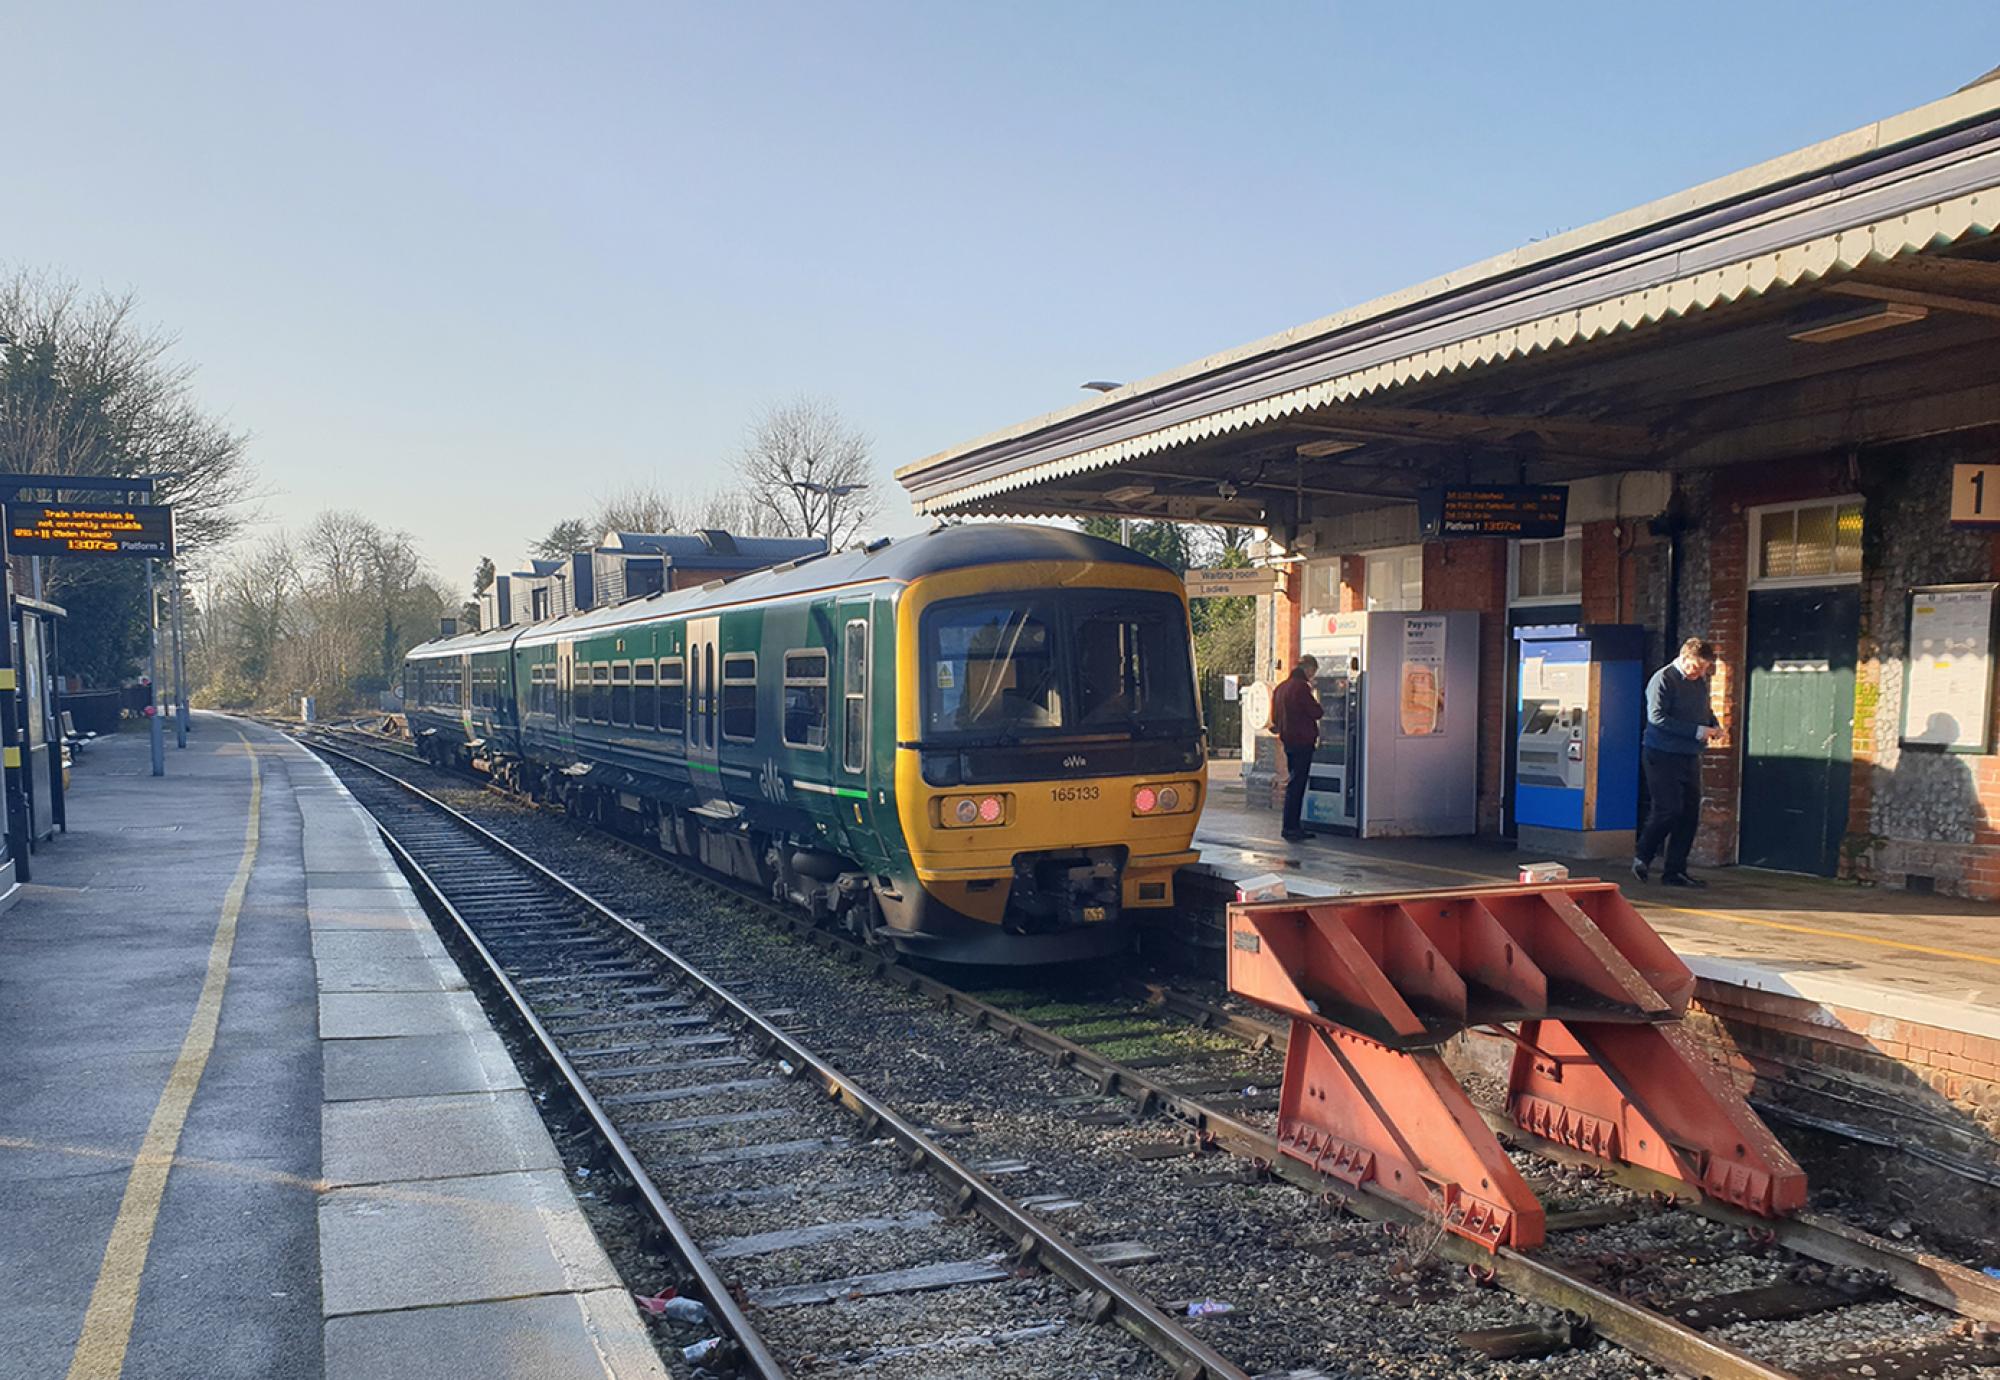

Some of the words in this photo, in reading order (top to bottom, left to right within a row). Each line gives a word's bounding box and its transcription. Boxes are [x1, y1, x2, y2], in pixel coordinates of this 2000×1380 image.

[1970, 470, 1984, 514] 1
[44, 509, 70, 519] Train
[72, 511, 122, 520] information
[124, 511, 135, 520] is
[37, 520, 53, 528] not
[55, 521, 99, 531] currently
[100, 521, 143, 530] available
[1444, 521, 1475, 531] Platform
[121, 541, 158, 551] Platform
[159, 542, 166, 551] 2
[1201, 571, 1233, 580] Waiting
[1235, 571, 1259, 579] room
[1201, 585, 1230, 593] Ladies
[1407, 620, 1421, 630] Pay
[1423, 621, 1443, 630] your
[1062, 755, 1087, 768] GWR
[1051, 786, 1099, 801] 165133
